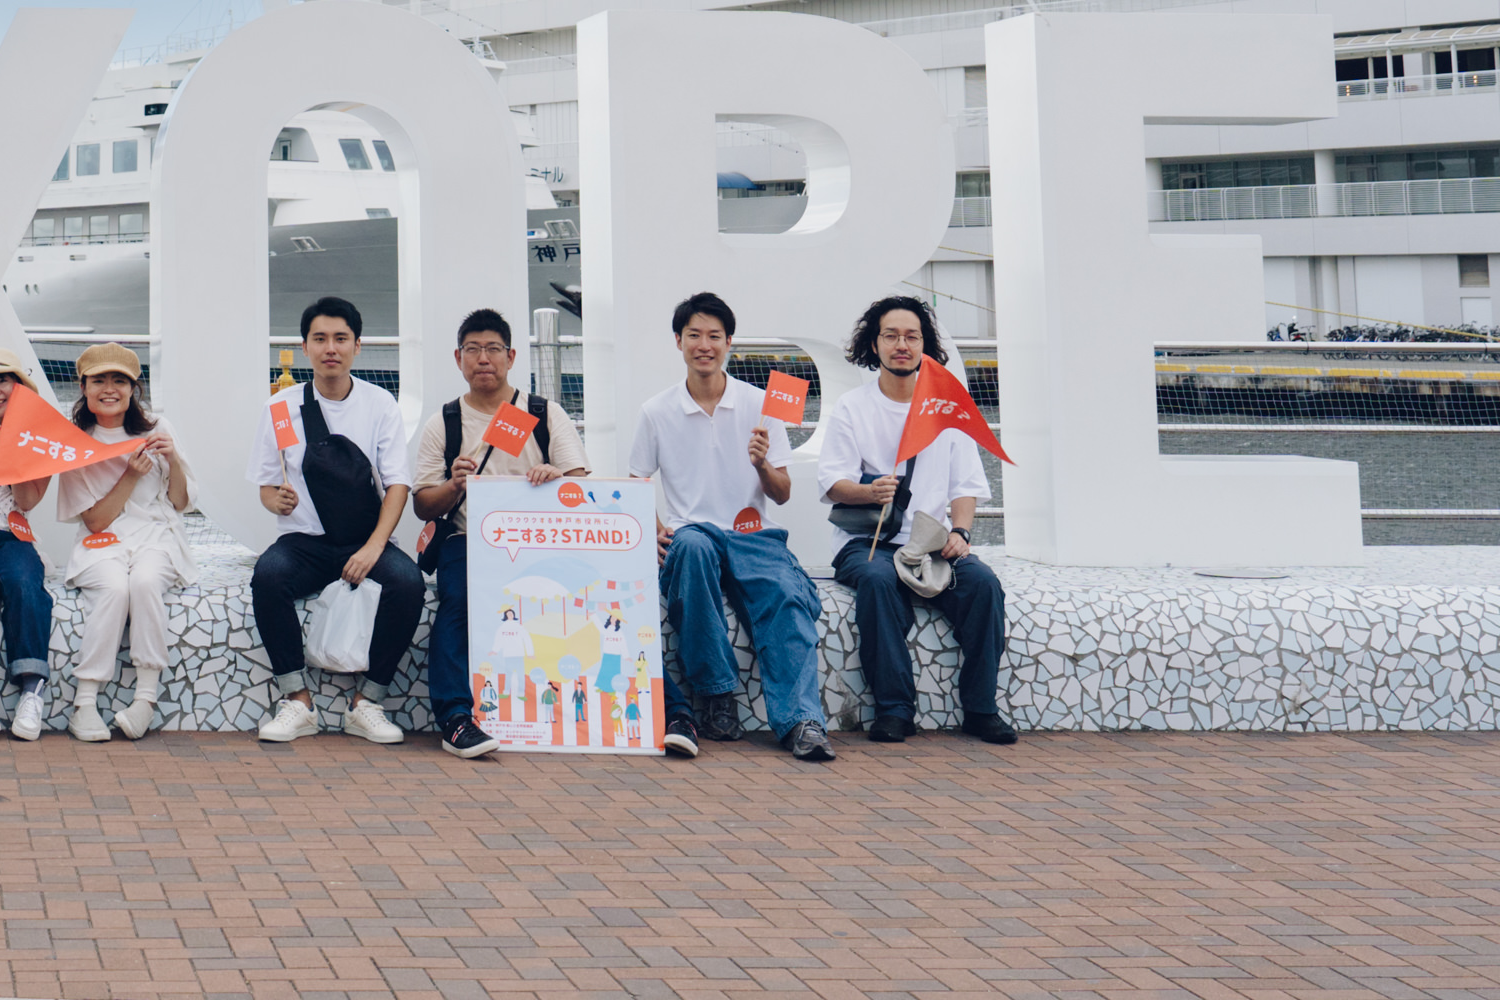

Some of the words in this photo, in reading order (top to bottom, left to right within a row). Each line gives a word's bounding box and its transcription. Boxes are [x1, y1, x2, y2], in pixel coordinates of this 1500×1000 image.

[770, 389, 800, 405] ナニする？
[495, 419, 525, 439] ナニする？
[17, 430, 94, 462] ナニする？
